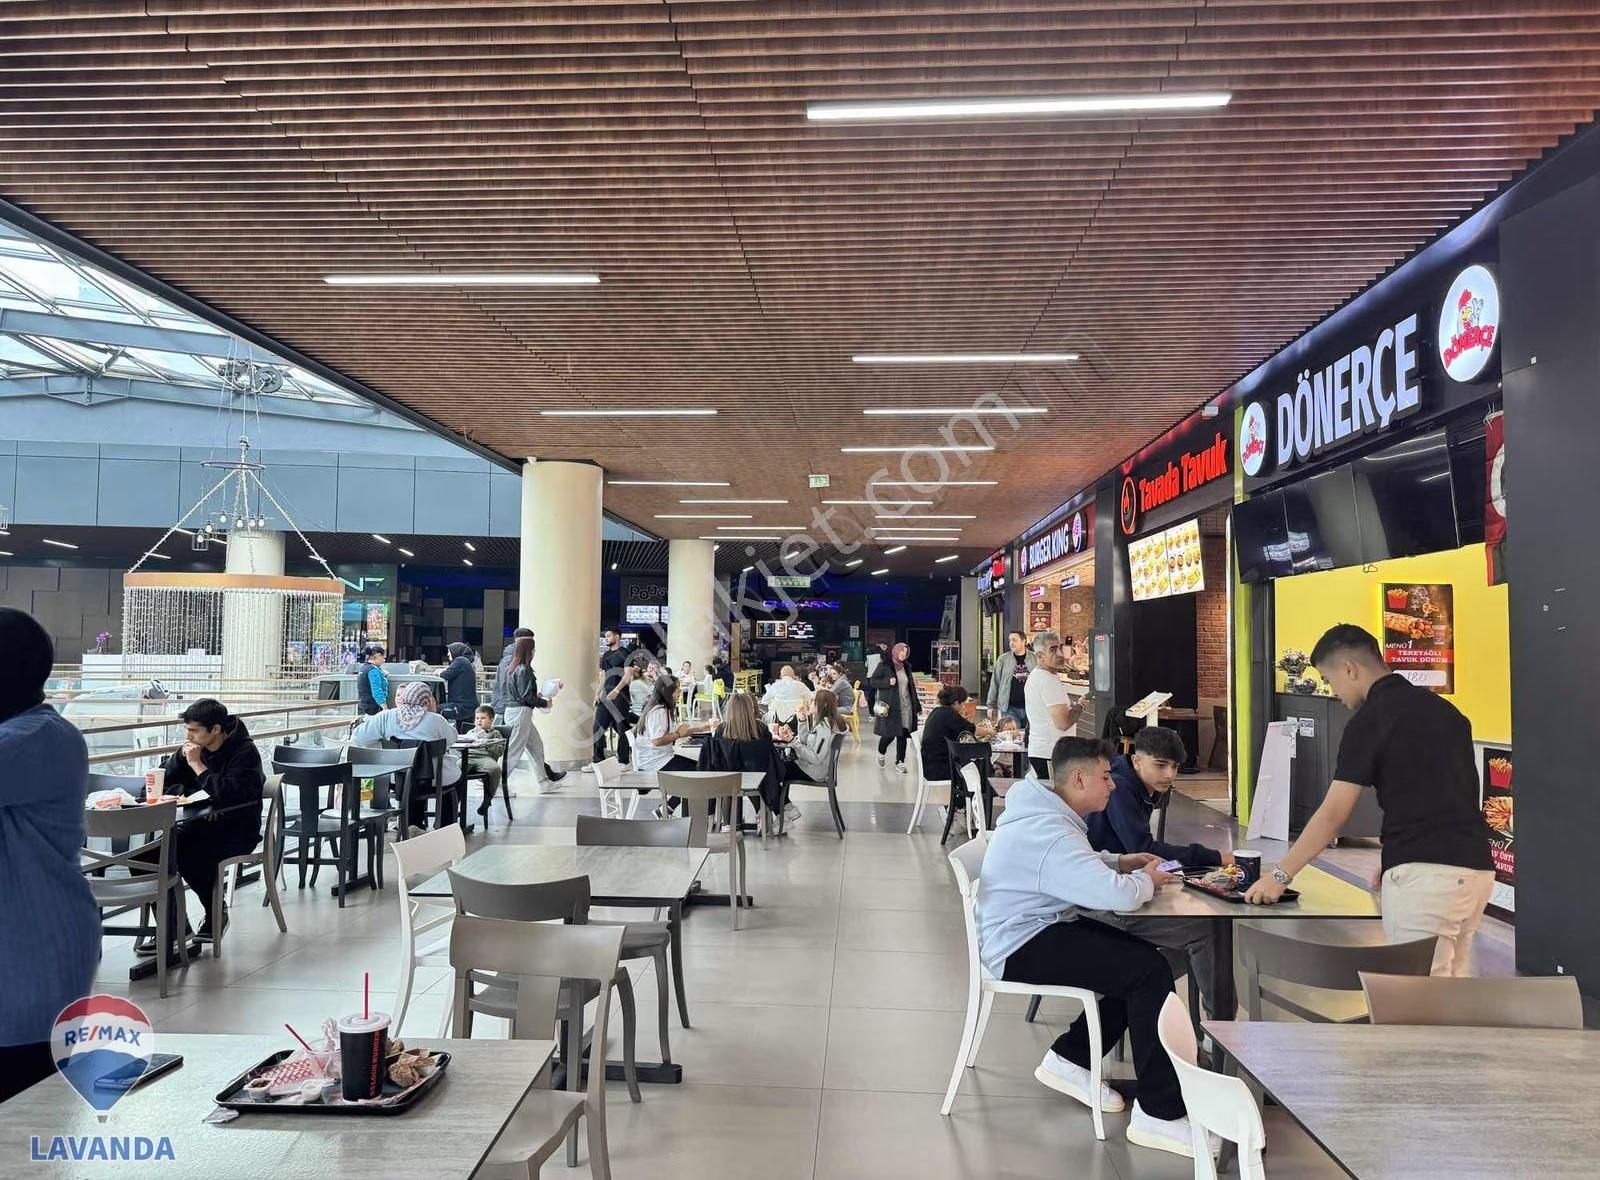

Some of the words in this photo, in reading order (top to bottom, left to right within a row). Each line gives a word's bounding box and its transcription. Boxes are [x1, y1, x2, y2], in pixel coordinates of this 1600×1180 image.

[1443, 325, 1495, 369] DÖNERÇE
[1277, 313, 1419, 466] DÖNERÇE
[1138, 460, 1180, 513] Tavada
[1180, 434, 1229, 493] Tavuk
[1029, 534, 1052, 570] BURGER
[1052, 522, 1069, 560] KING
[1494, 860, 1514, 874] AVUK
